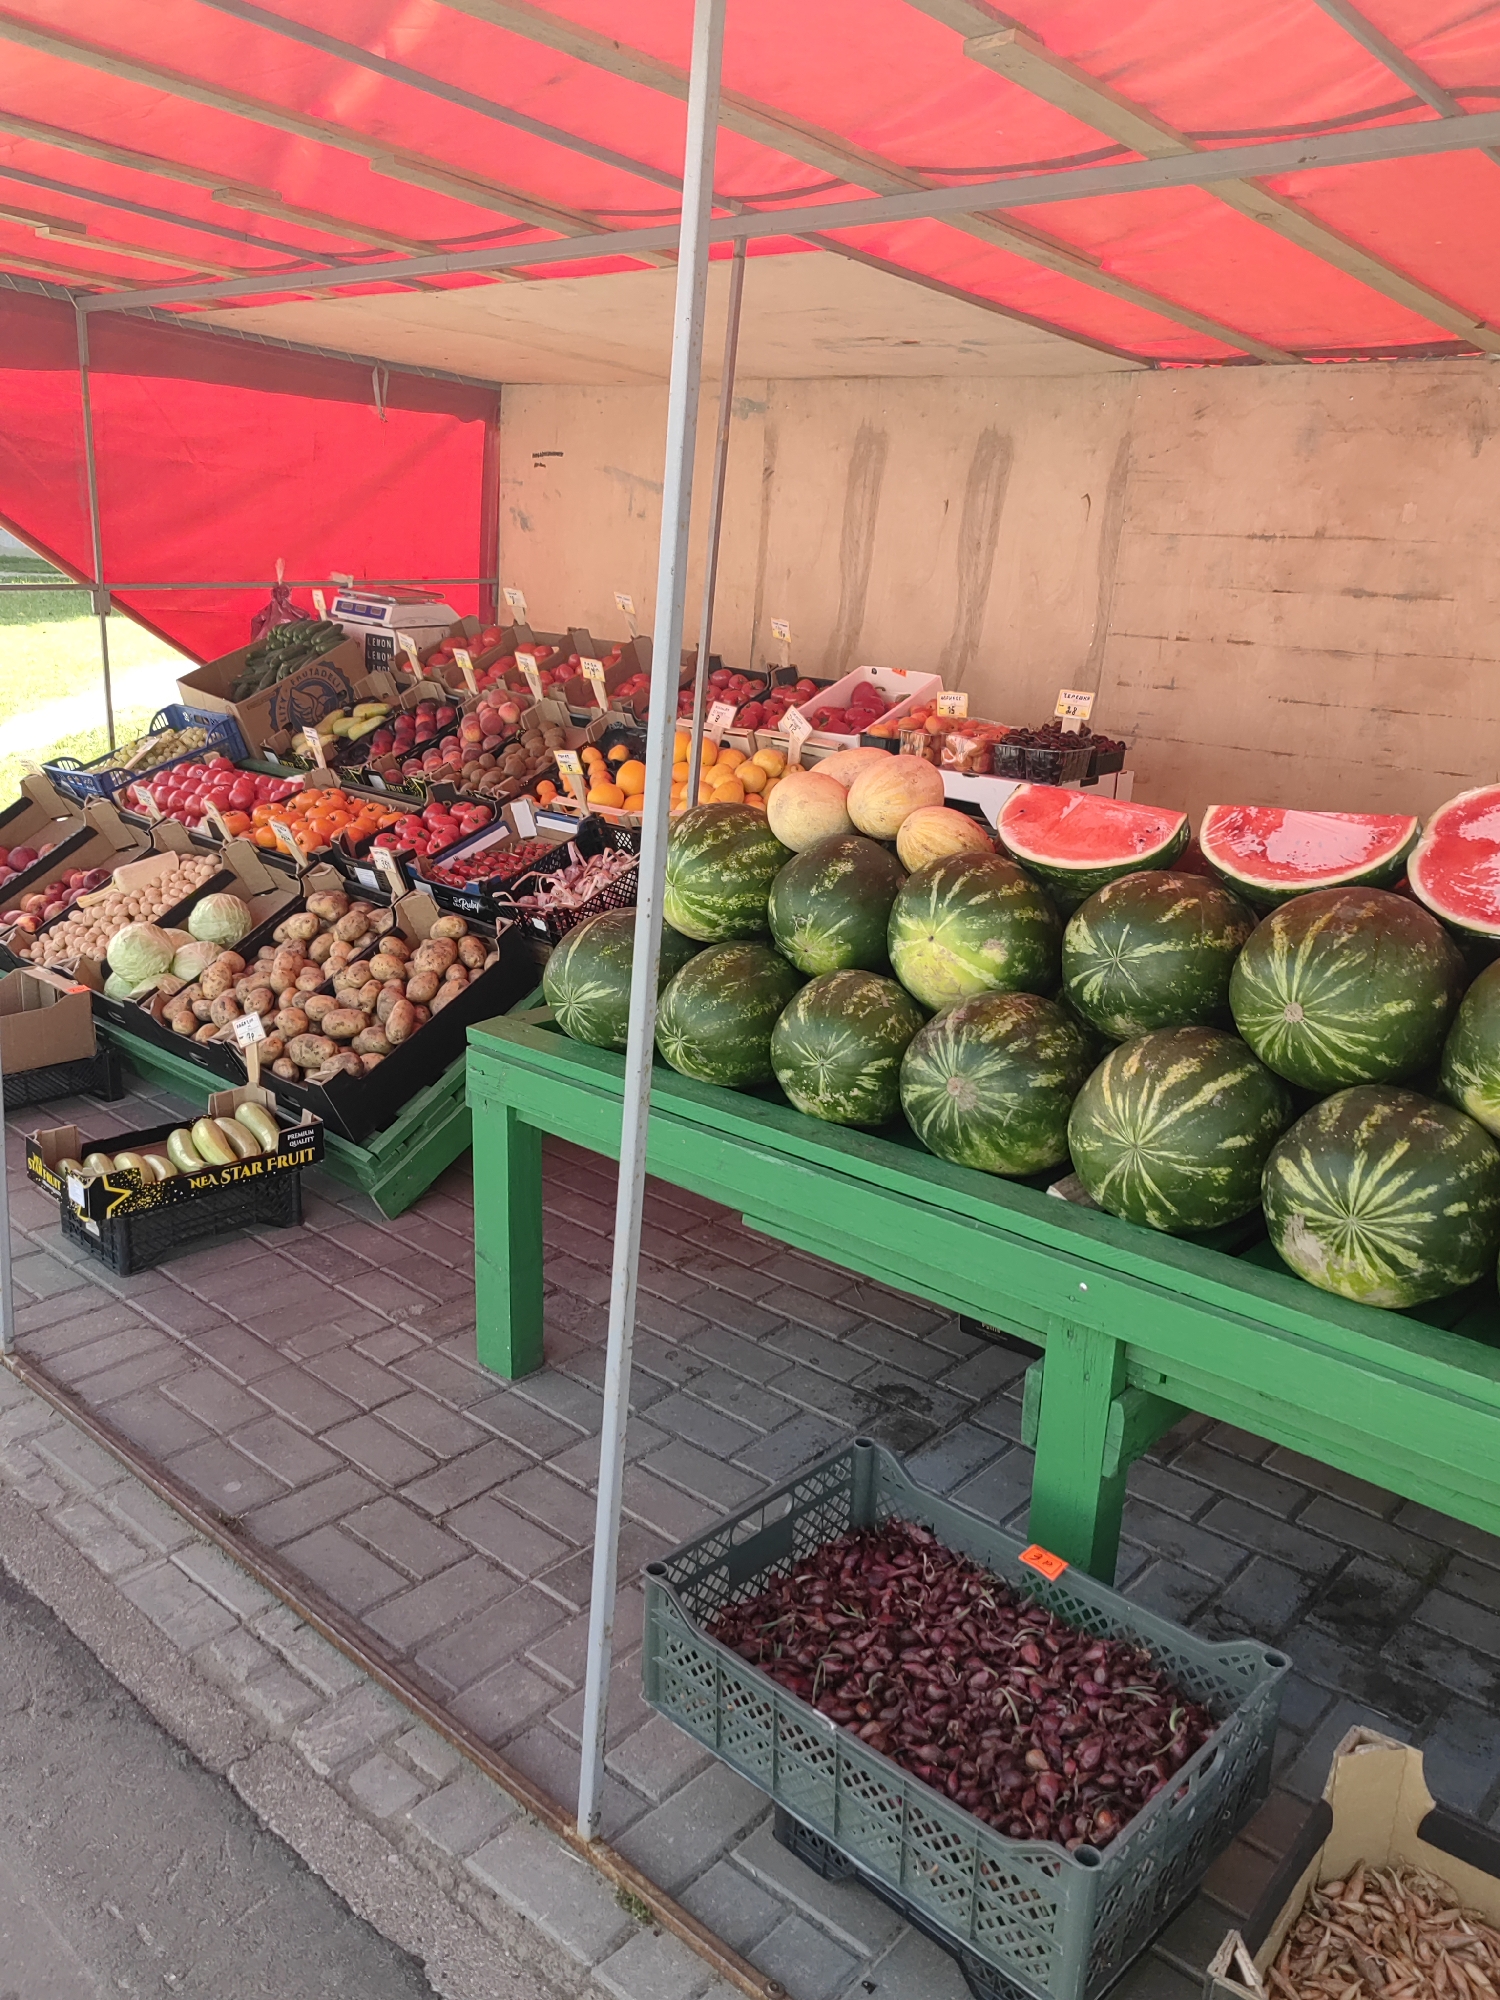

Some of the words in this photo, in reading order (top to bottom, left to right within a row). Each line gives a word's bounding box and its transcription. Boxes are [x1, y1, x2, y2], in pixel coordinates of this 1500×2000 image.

[366, 636, 393, 649] LEMON
[458, 897, 480, 914] Ruby
[287, 1129, 315, 1141] PREMIUM
[289, 1136, 315, 1148] QUALITY
[220, 1161, 265, 1185] STAR
[266, 1147, 316, 1173] FRUIT
[42, 1168, 62, 1191] FRUIT
